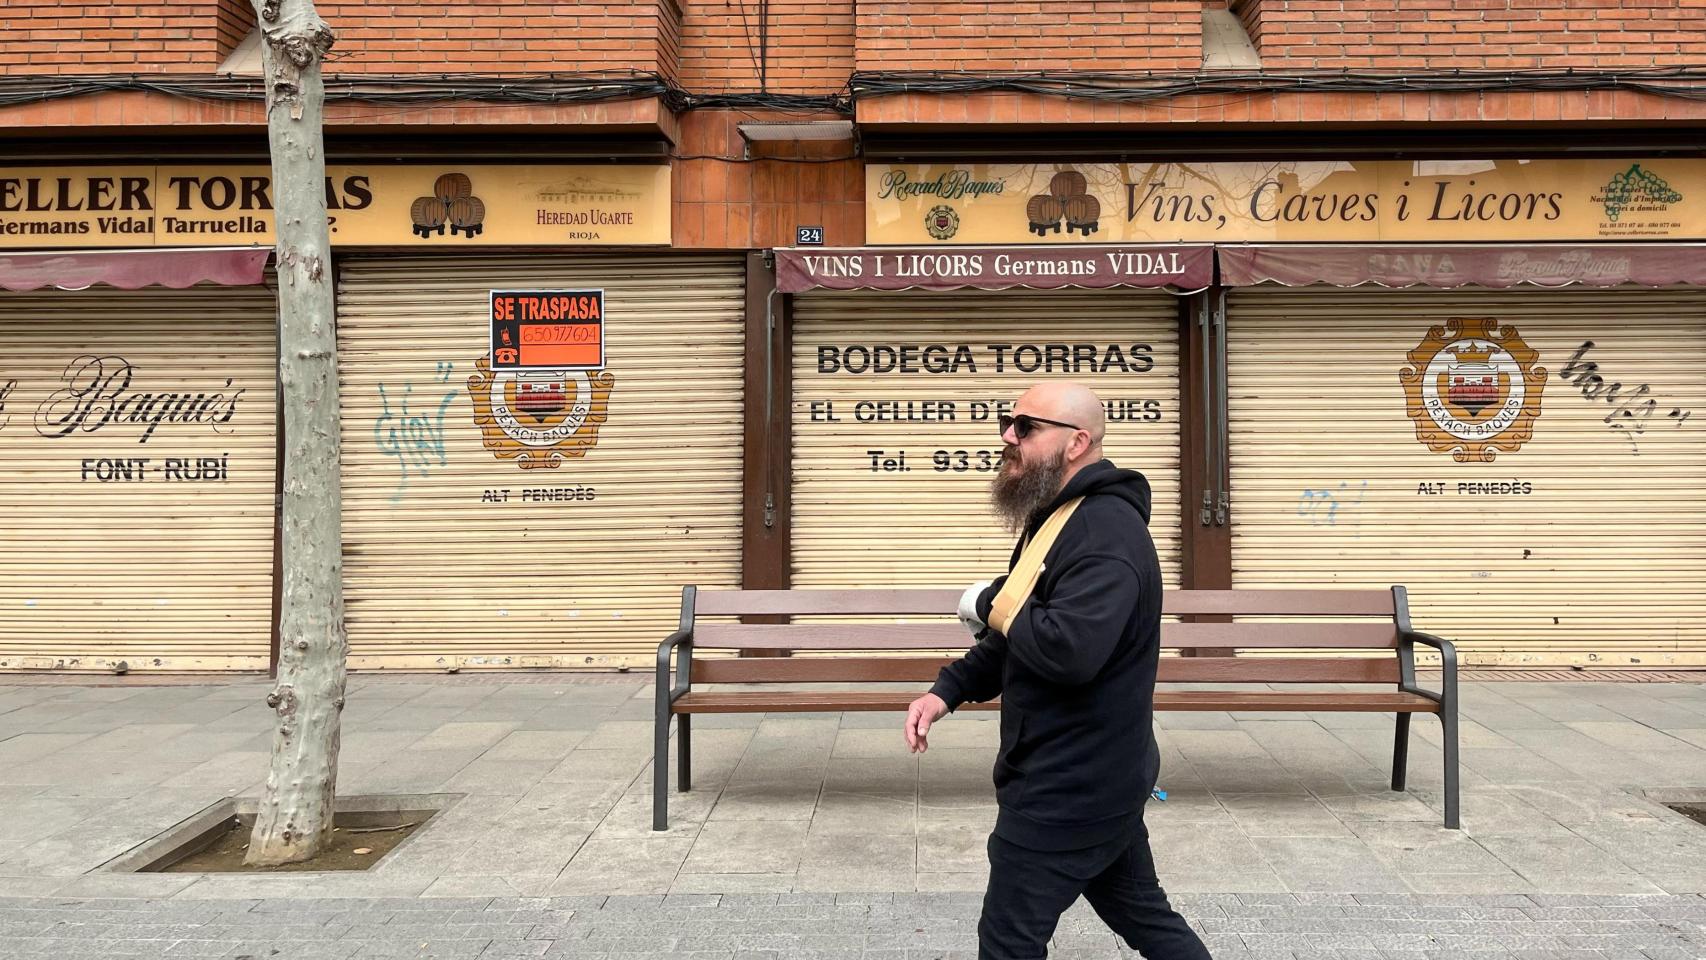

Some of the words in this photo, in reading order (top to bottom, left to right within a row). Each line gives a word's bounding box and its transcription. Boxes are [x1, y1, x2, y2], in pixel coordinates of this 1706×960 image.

[1124, 182, 1227, 231] Vins,
[1249, 181, 1378, 222] Caves
[1396, 180, 1410, 221] i
[1427, 180, 1562, 221] Licors
[1637, 203, 1667, 211] domicili
[97, 216, 154, 234] Vidal
[163, 216, 267, 233] Tarruella
[537, 209, 588, 225] HEREDAD
[590, 209, 633, 225] UGARTE
[569, 232, 600, 240] RIOJA
[800, 229, 820, 242] 24
[802, 255, 862, 277] VINS
[874, 256, 884, 277] I
[896, 254, 983, 277] LICORS
[994, 254, 1096, 276] Germans
[1107, 252, 1185, 276] VIDAL
[494, 297, 514, 320] SE
[519, 297, 600, 320] TRASPASA
[817, 345, 977, 374] BODEGA
[987, 344, 1155, 373] TORRAS
[810, 400, 840, 422] EL
[855, 400, 956, 423] CELLER
[867, 450, 911, 472] Tel.
[482, 489, 510, 502] ALT
[522, 484, 595, 502] PENEDÈS
[1417, 482, 1446, 495] ALT
[1458, 477, 1532, 495] PENEDÈS
